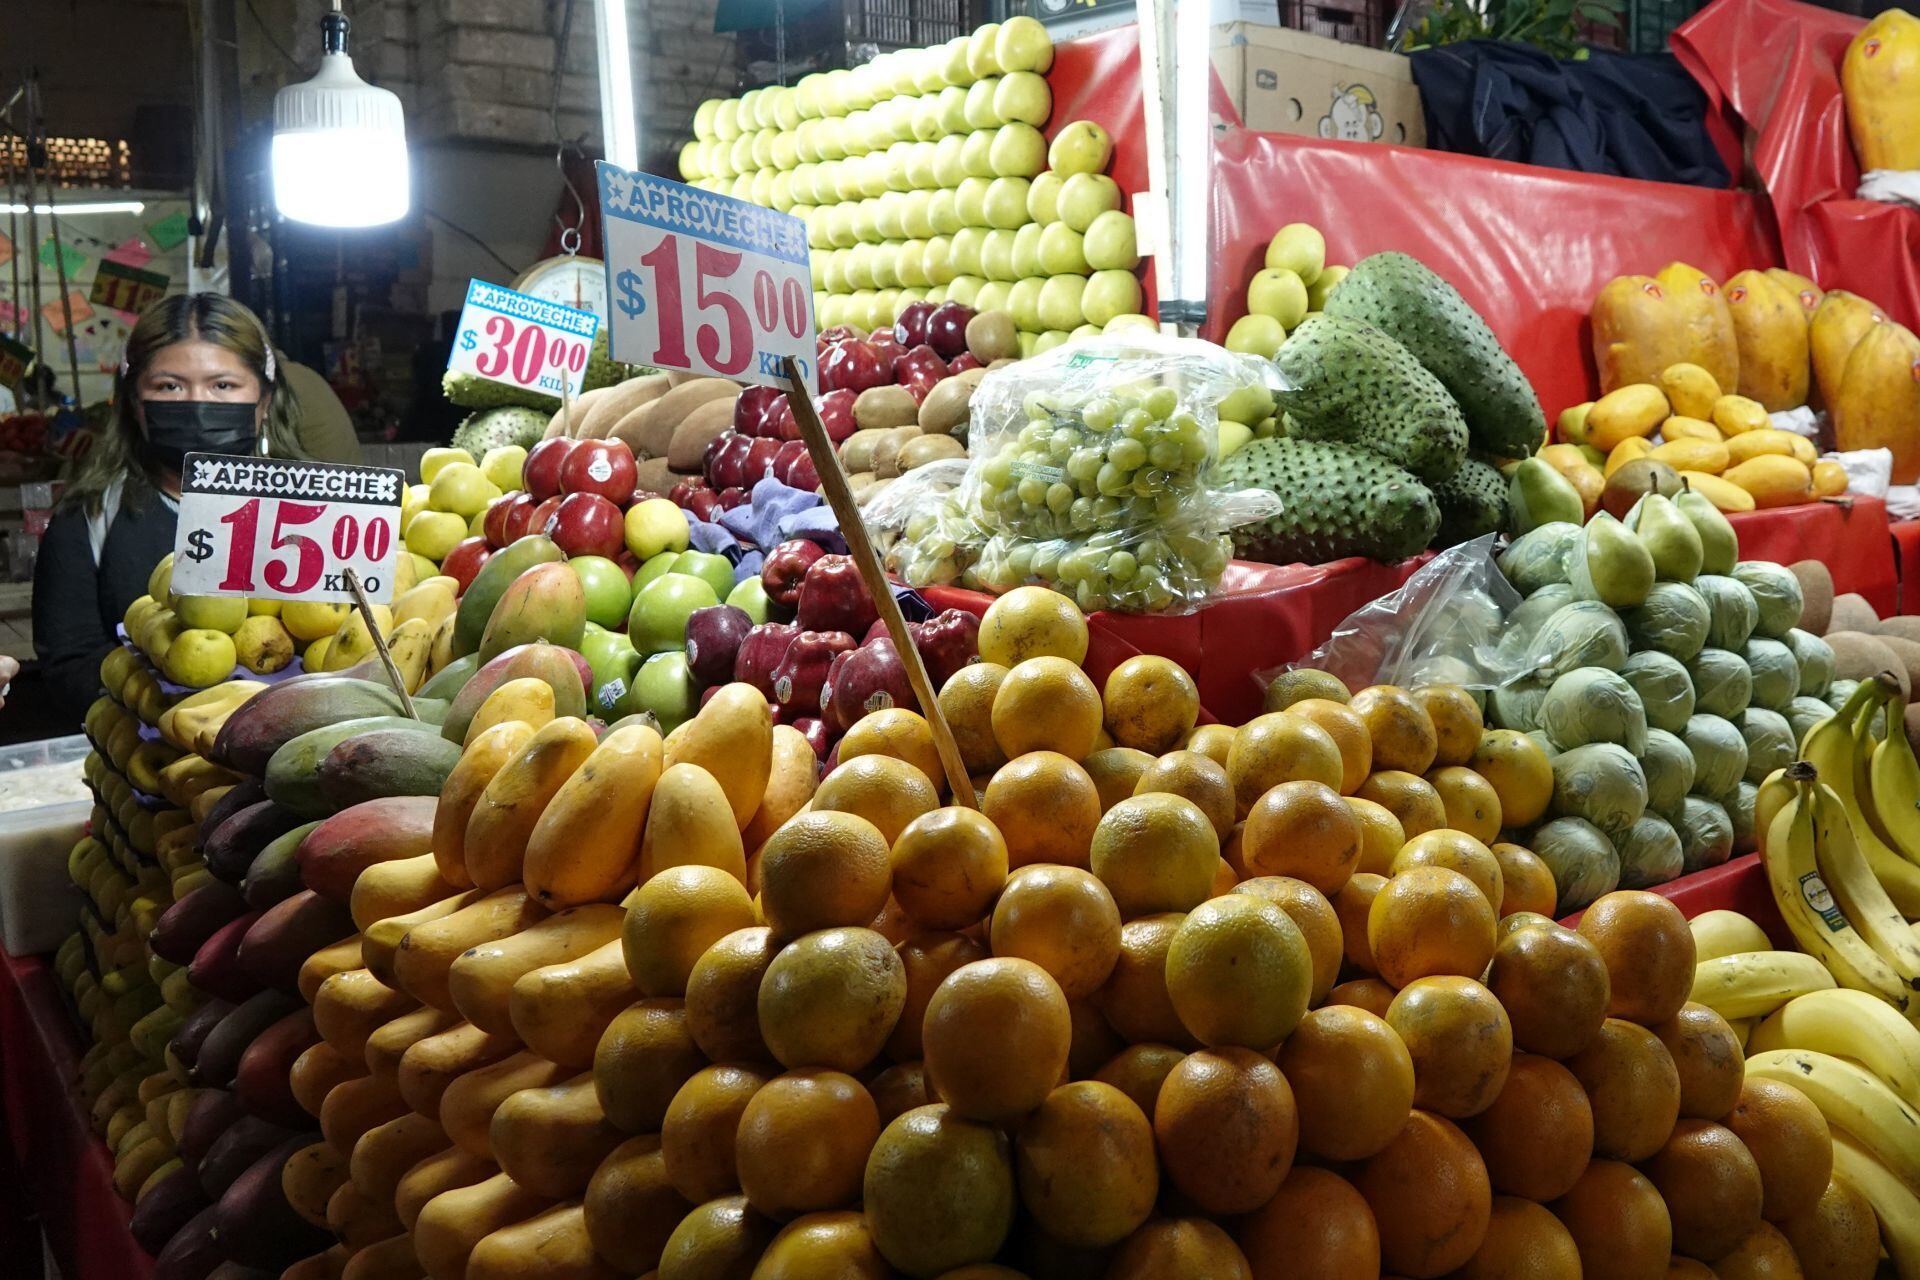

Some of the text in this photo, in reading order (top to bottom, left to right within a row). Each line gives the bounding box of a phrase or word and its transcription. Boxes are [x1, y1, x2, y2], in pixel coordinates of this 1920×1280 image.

[629, 184, 787, 247] APROVECHE
[485, 292, 584, 327] APROVECHE
[758, 351, 808, 381] KI
[213, 467, 380, 495] APROVECHE
[323, 573, 381, 593] KIO
